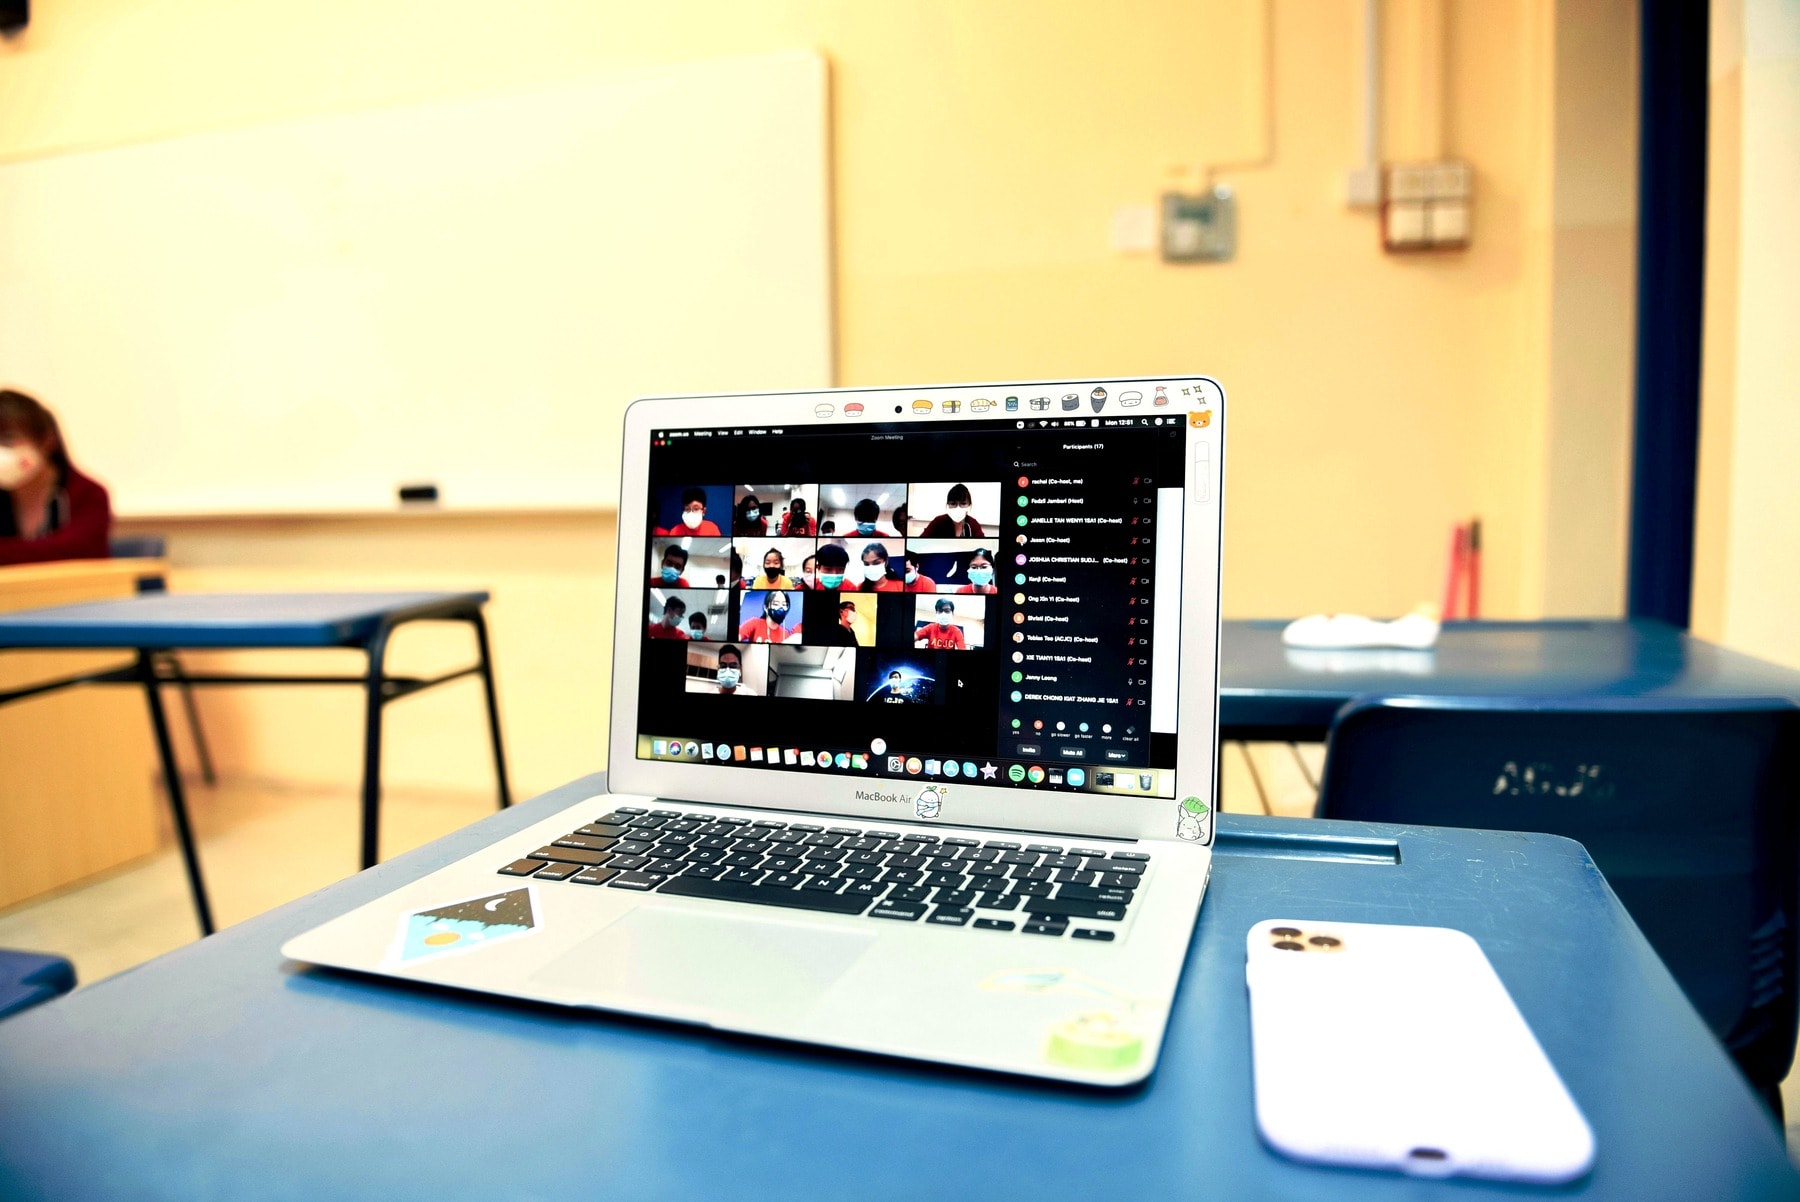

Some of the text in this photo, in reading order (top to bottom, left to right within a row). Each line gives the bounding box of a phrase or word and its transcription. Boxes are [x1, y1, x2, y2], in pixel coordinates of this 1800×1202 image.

[1105, 418, 1117, 426] Mon
[1097, 517, 1123, 525] (Co-host)
[931, 638, 954, 648] ACJC
[1066, 655, 1092, 663] (Co-host)
[855, 790, 912, 804] MacBook Air
